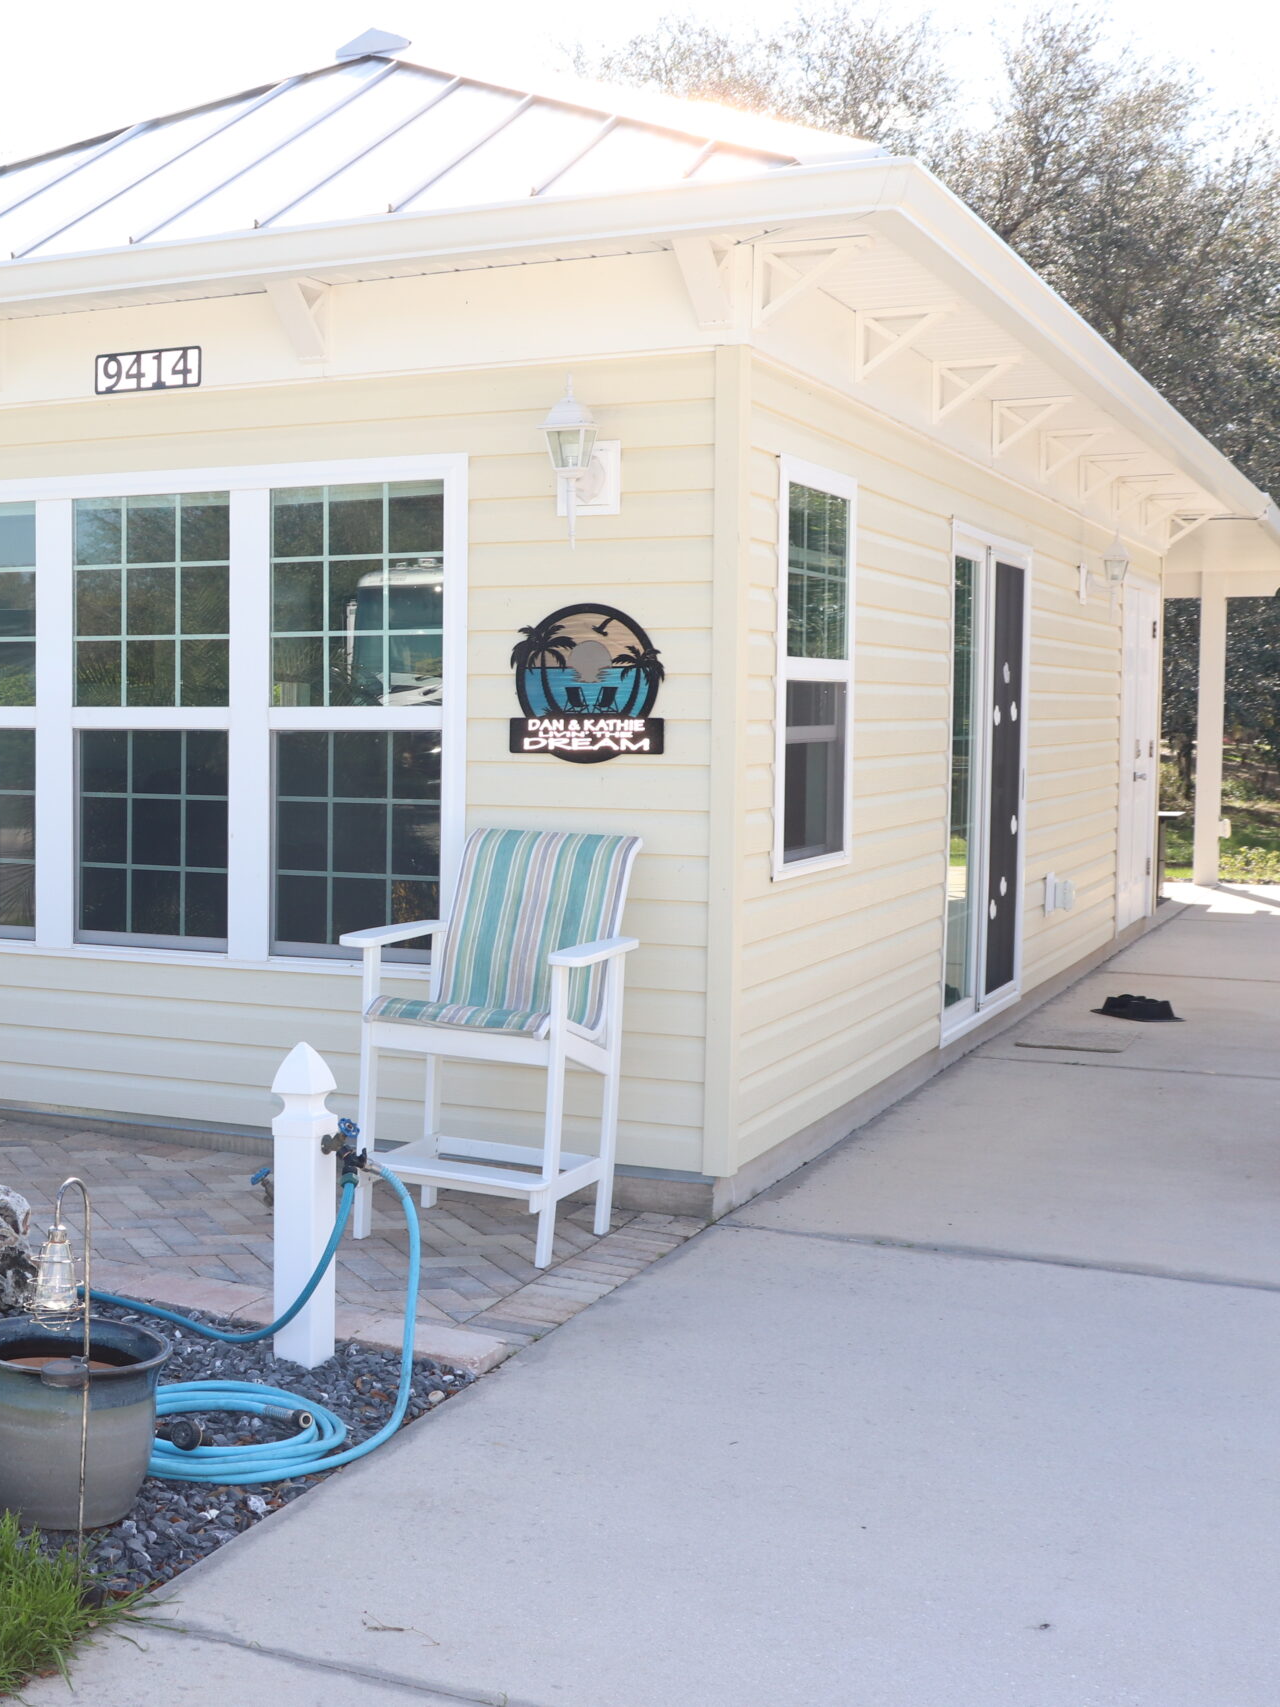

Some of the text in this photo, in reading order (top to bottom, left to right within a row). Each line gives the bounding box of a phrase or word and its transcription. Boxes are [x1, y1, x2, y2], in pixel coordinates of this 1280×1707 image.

[103, 348, 192, 392] 9414
[528, 719, 646, 732] DAN & KATHIE
[523, 738, 650, 751] DREAM
